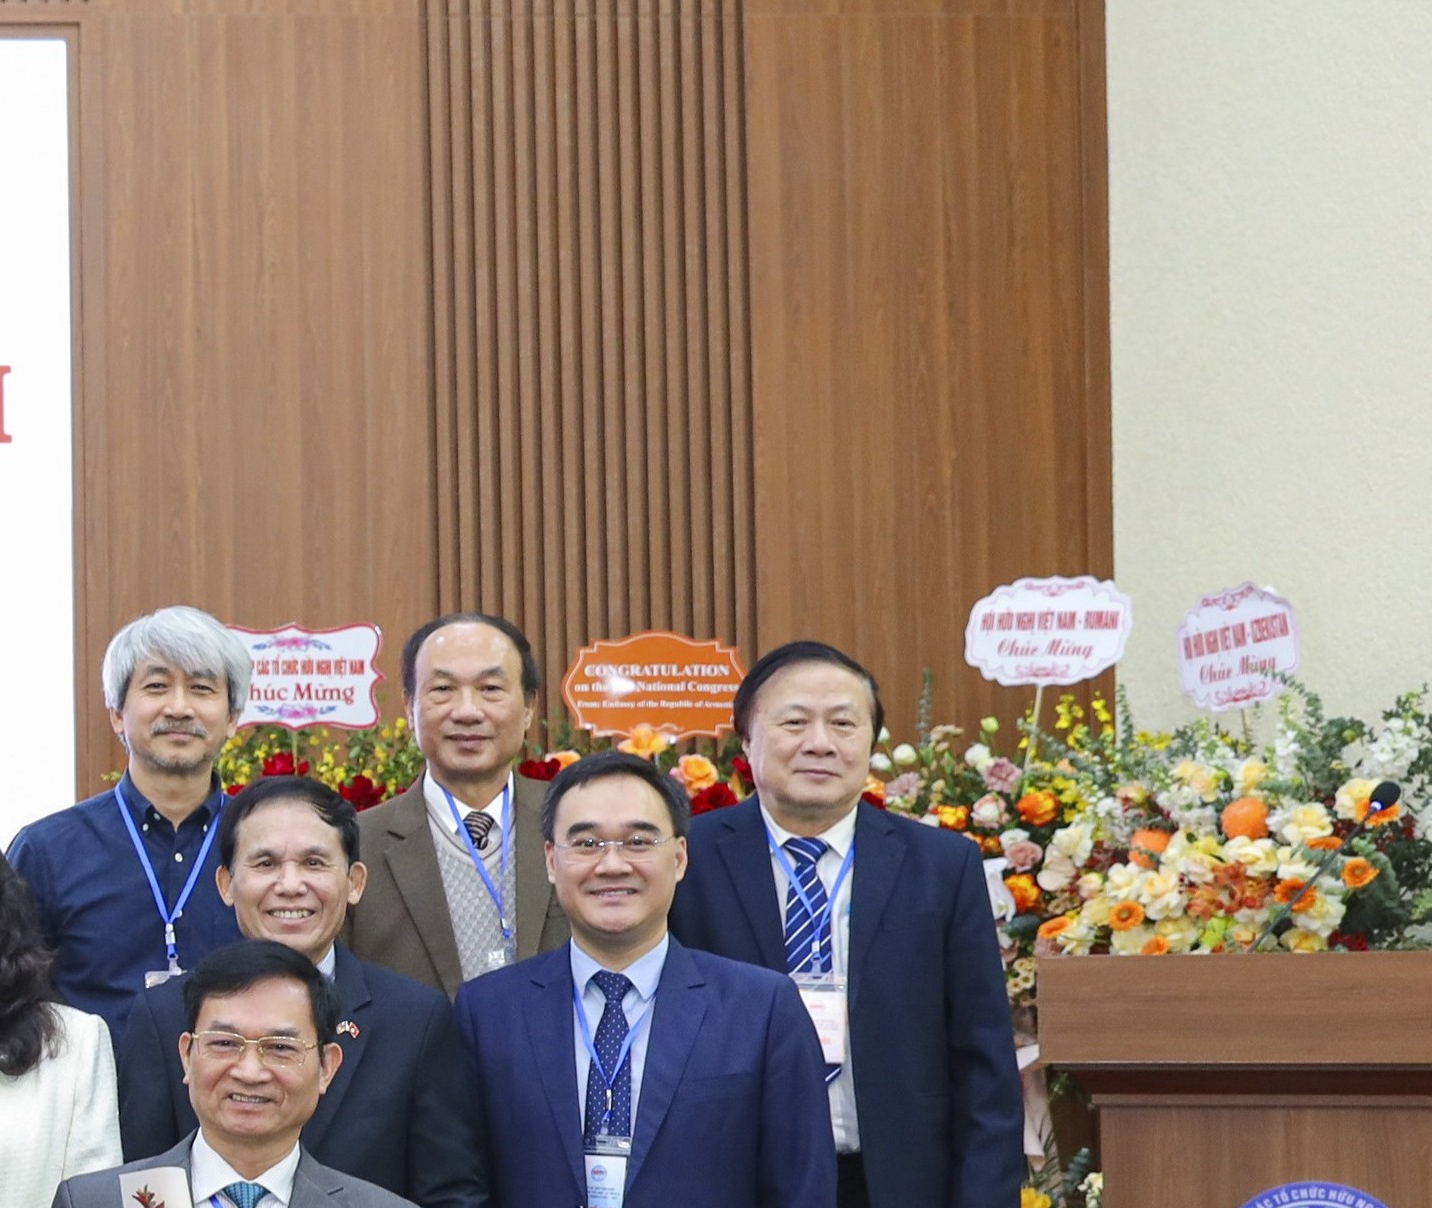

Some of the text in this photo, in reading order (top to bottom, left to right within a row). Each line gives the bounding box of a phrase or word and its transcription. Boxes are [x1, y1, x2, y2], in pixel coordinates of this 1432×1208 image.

[350, 658, 365, 676] NAM
[584, 663, 730, 677] CONGRATULATION
[249, 682, 354, 705] húc Mừng
[636, 680, 686, 693] National
[1272, 1187, 1289, 1205] TỔ
[1290, 1186, 1326, 1201] CHỨC
[1328, 1187, 1356, 1206] HỮU
